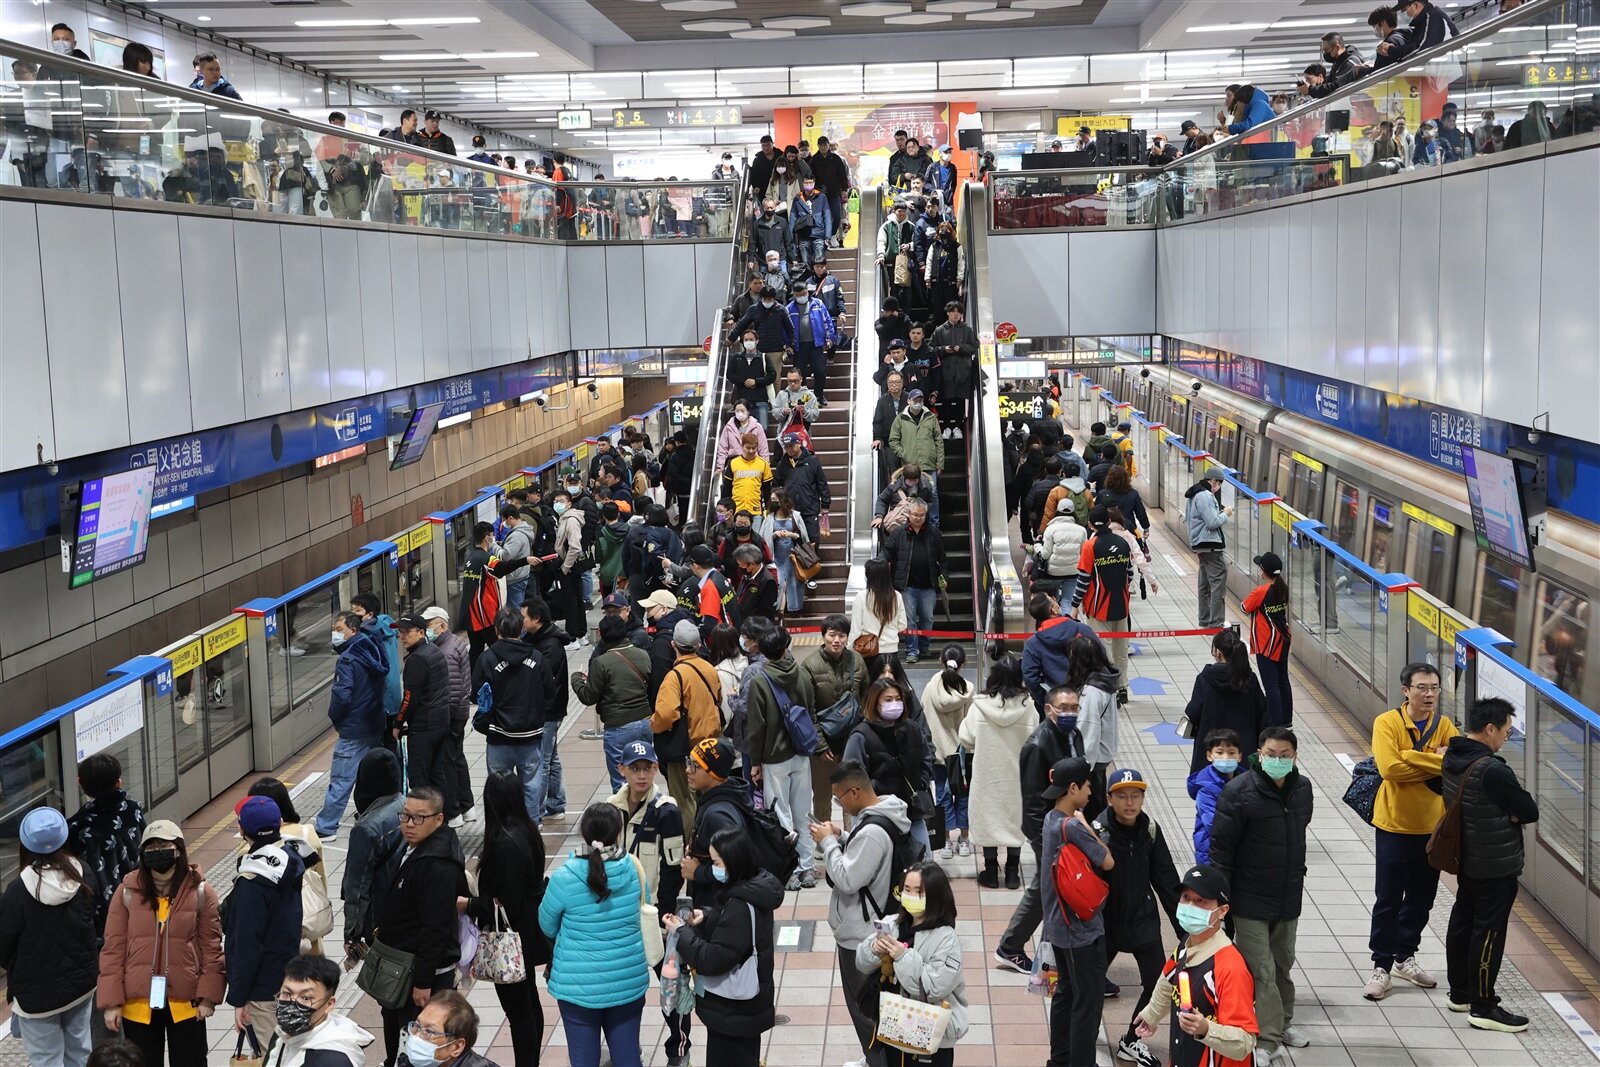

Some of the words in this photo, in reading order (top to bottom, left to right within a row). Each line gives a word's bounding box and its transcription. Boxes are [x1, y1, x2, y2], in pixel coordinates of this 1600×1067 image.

[633, 111, 641, 121] 5
[695, 111, 703, 120] 4
[715, 109, 723, 119] 3
[805, 115, 815, 128] 3
[1432, 419, 1439, 434] BL
[1441, 412, 1481, 447] 國父紀念館
[1432, 437, 1438, 451] 17
[147, 439, 202, 473] 國父紀念館
[161, 472, 180, 483] YAT-SEN
[180, 465, 203, 480] MEMORIAL
[203, 463, 215, 474] HALL
[273, 613, 277, 629] 4
[1463, 646, 1467, 666] 3
[166, 669, 172, 688] 4
[631, 742, 647, 756] TB
[1120, 770, 1133, 783] B
